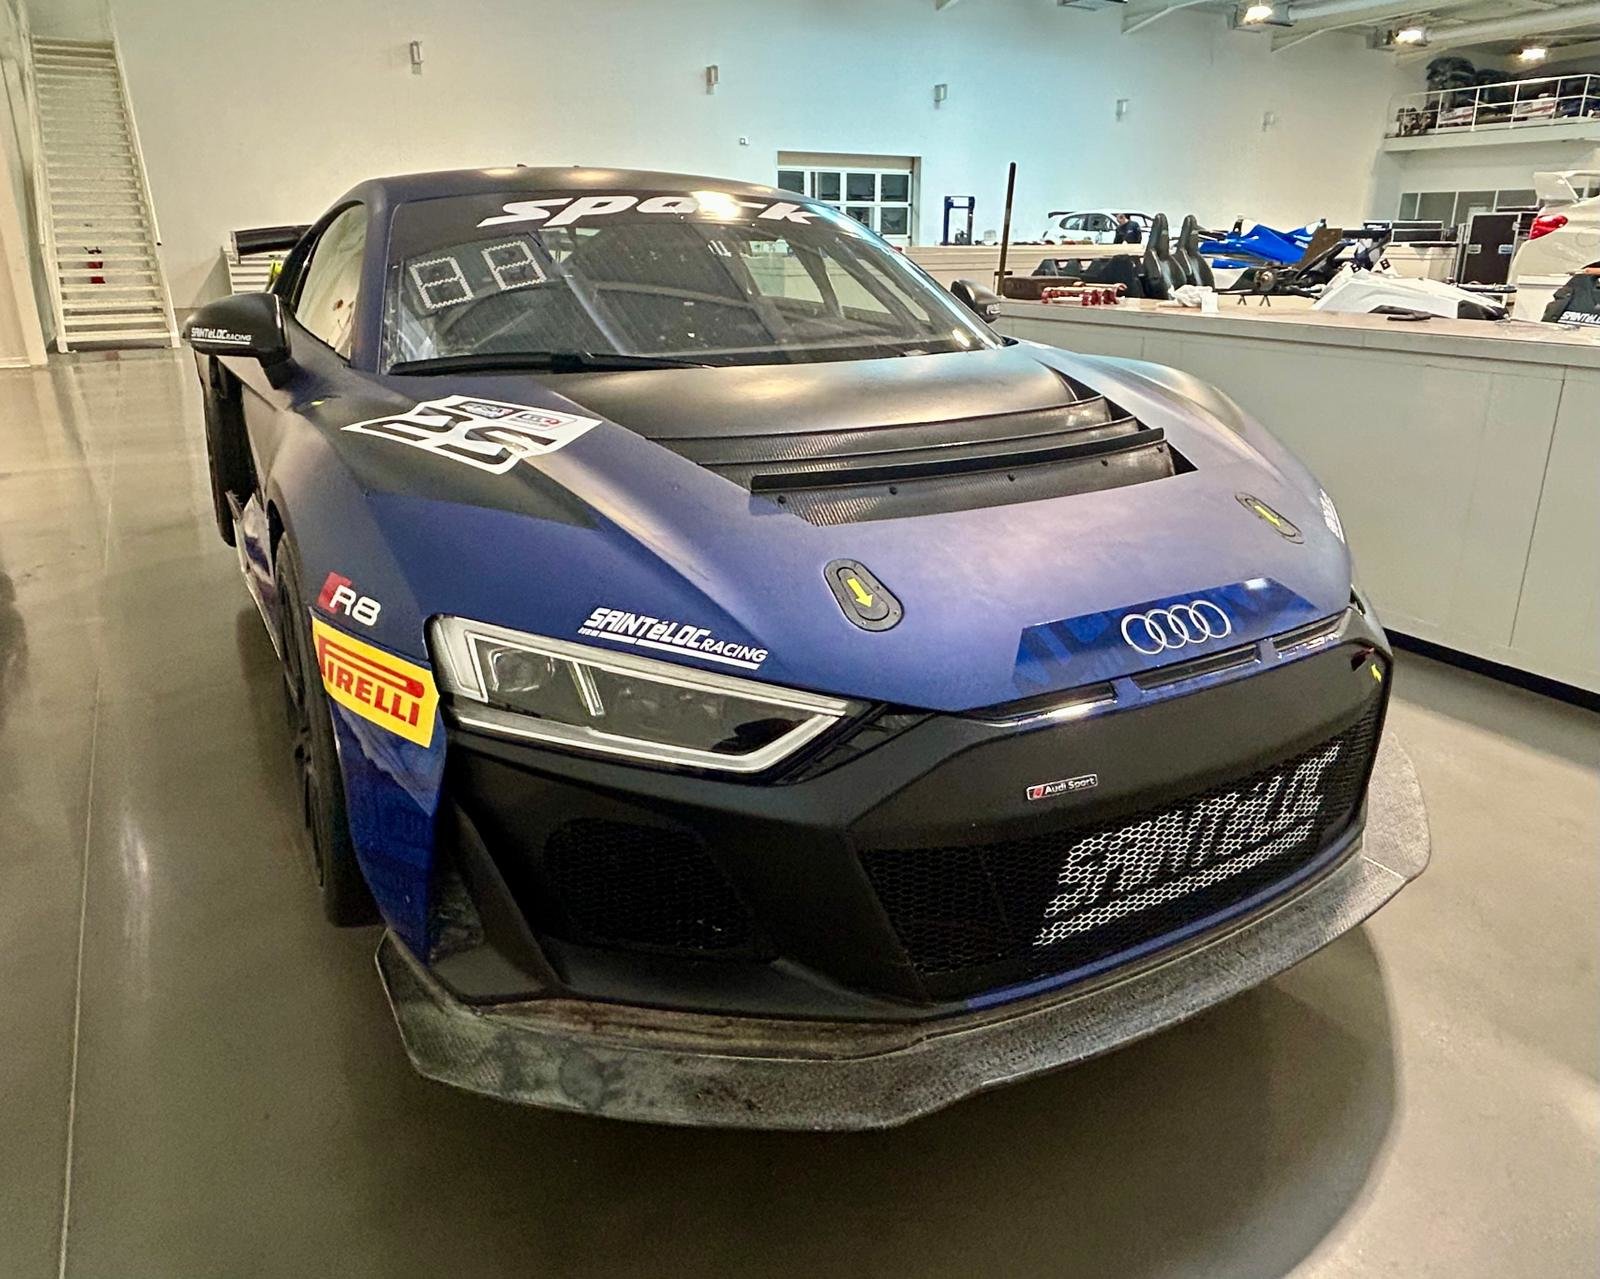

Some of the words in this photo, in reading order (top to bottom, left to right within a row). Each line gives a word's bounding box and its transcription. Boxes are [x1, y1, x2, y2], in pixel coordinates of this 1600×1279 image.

[476, 196, 821, 227] spak
[329, 584, 381, 626] R8
[699, 638, 768, 663] RACING
[318, 634, 425, 727] PIRELLI
[1045, 783, 1067, 794] Audi
[1068, 777, 1095, 790] Sport
